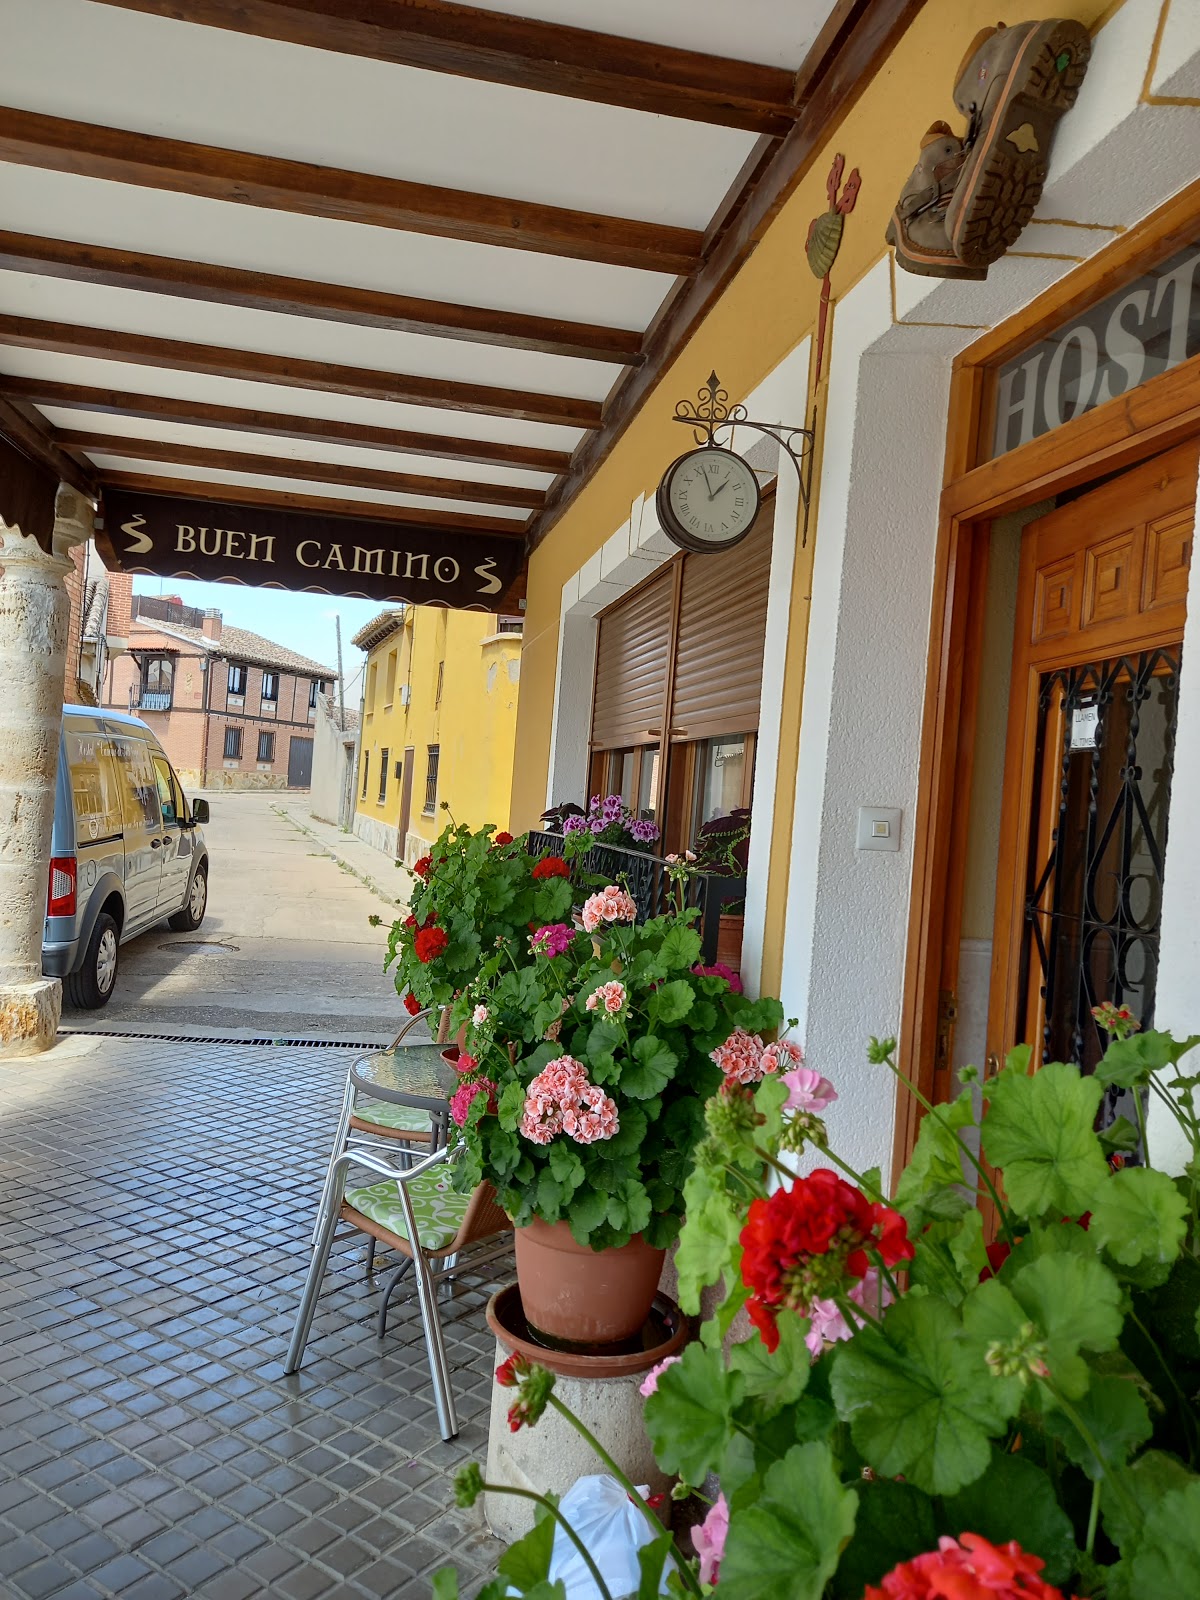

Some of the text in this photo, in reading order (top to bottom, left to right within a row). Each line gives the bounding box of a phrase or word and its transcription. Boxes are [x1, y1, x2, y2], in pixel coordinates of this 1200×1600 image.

[708, 464, 720, 475] XII
[724, 471, 731, 479] I
[683, 475, 693, 486] X
[732, 482, 742, 491] II
[734, 497, 744, 507] III
[703, 522, 714, 533] VI
[721, 522, 729, 531] V
[173, 524, 461, 583] BUEN CAMINO
[1075, 713, 1095, 722] LLAMEN
[1079, 737, 1095, 746] TIMBR
